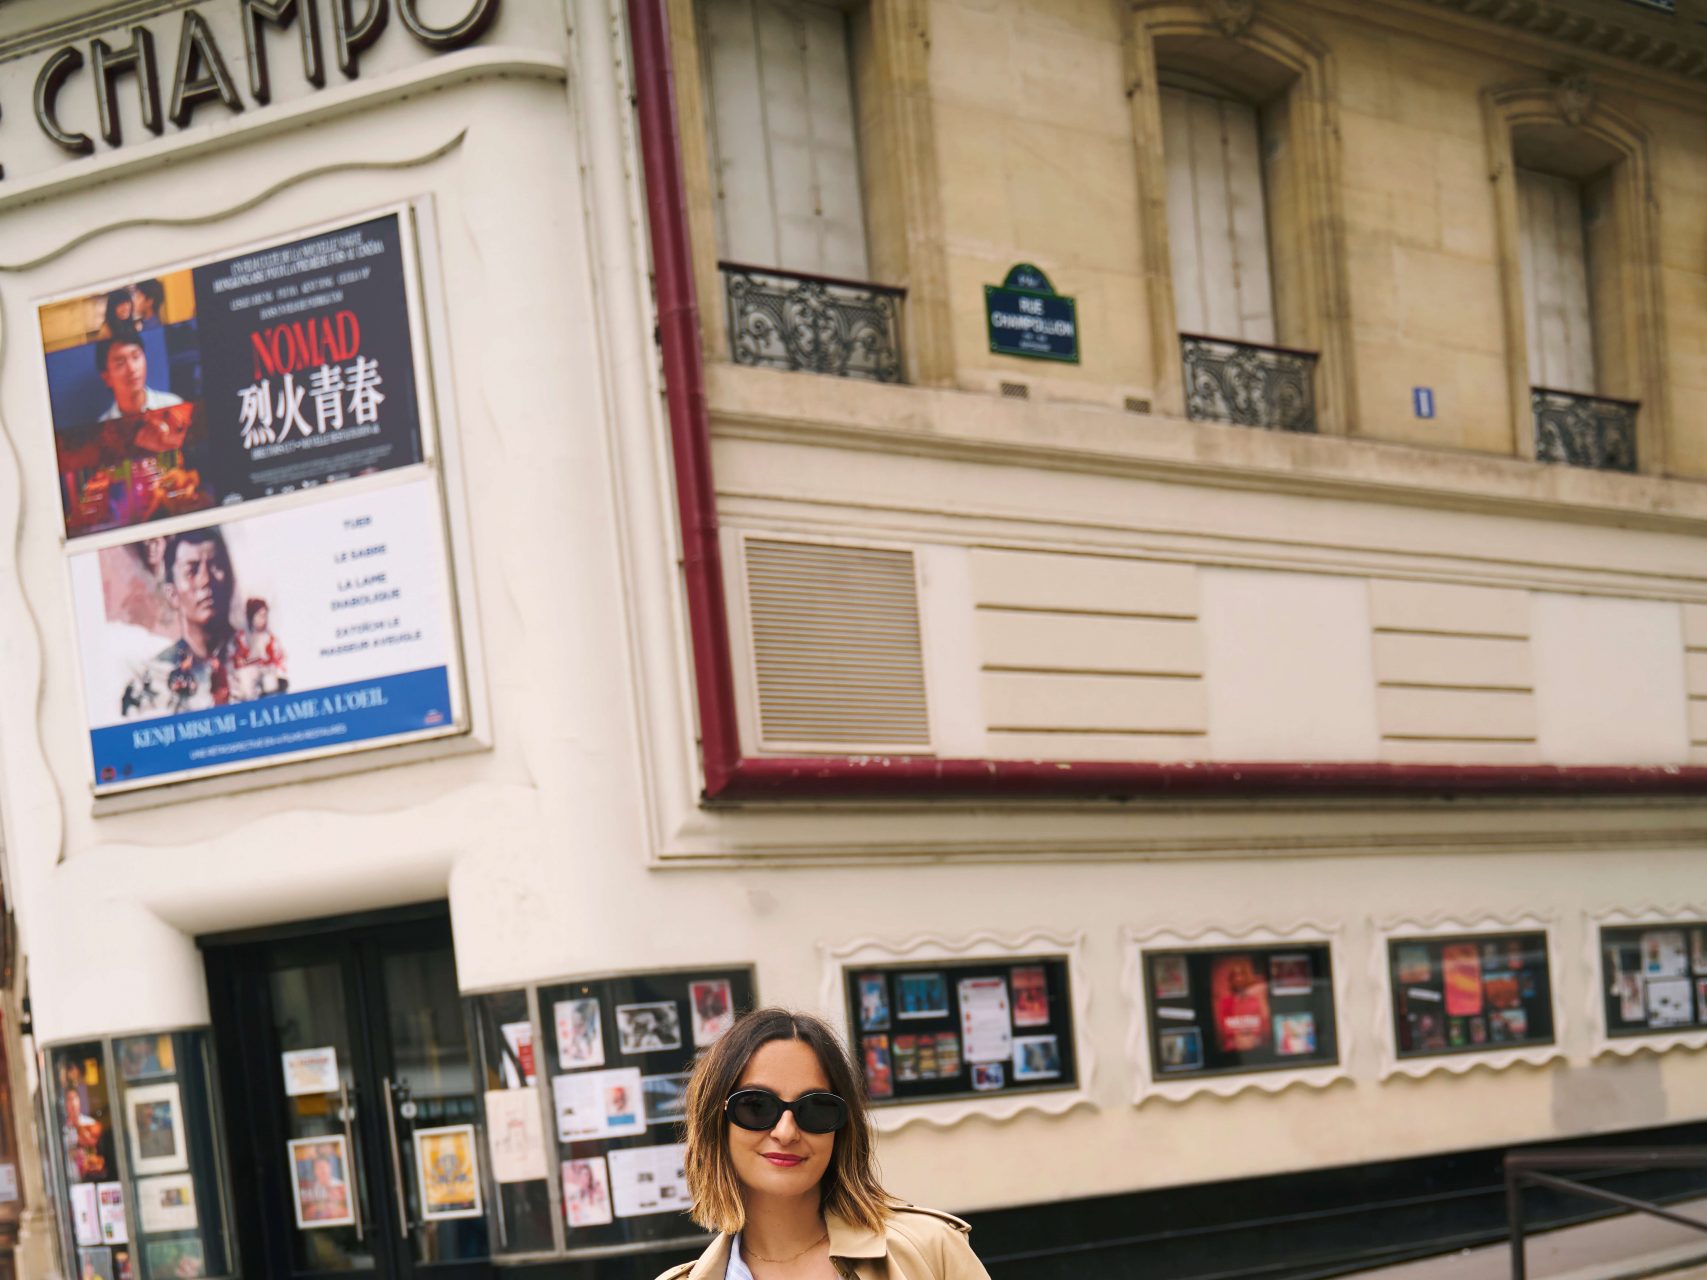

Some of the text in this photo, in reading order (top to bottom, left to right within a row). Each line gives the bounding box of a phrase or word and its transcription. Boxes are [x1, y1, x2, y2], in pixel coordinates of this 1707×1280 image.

[1018, 297, 1044, 315] RUE
[251, 310, 360, 380] NOMAD
[237, 355, 385, 449] 烈火青春
[132, 725, 176, 749] KENJI
[177, 713, 236, 742] MISUMI
[250, 706, 272, 729] LA
[273, 699, 319, 725] LAME
[320, 696, 333, 717] A
